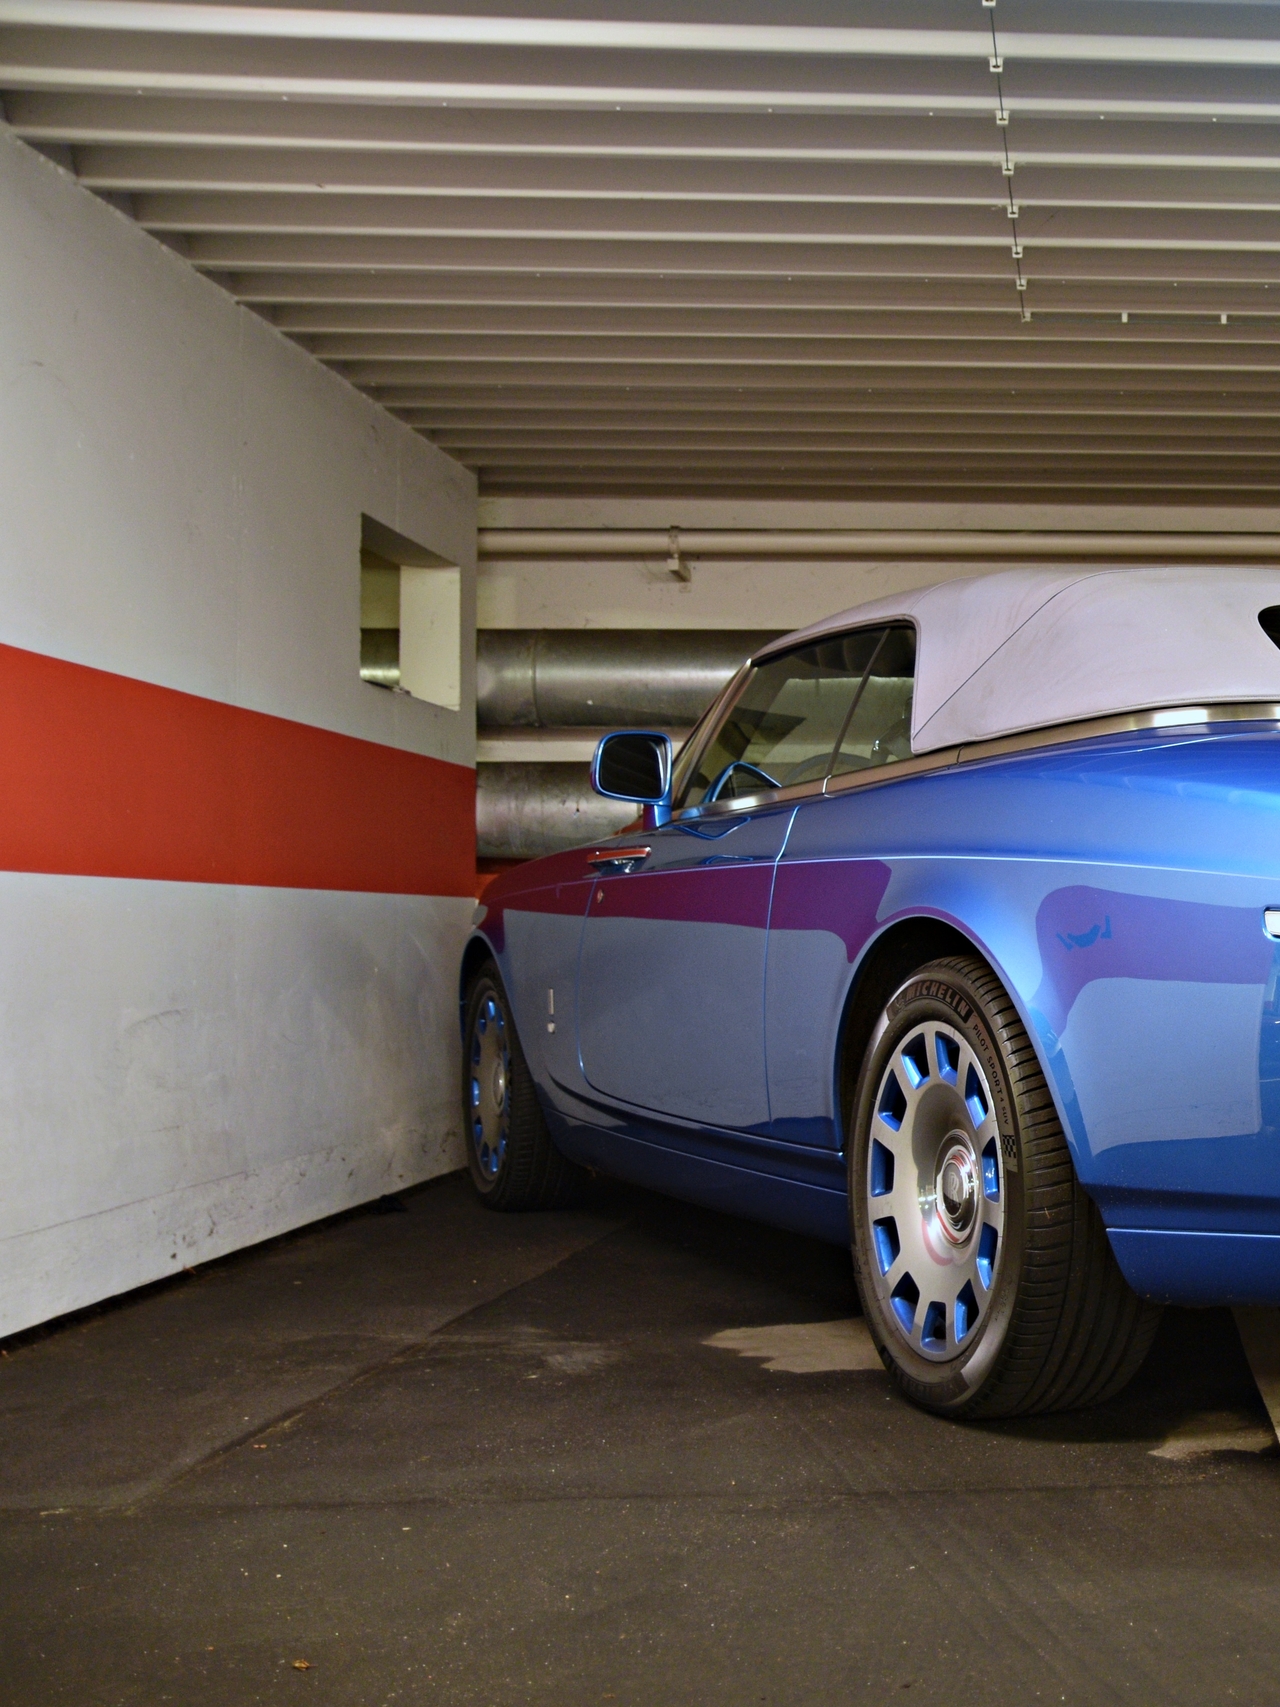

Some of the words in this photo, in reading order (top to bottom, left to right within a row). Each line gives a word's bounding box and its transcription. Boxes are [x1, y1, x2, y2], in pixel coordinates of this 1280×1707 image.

[906, 980, 970, 1017] MICHELIN
[972, 1024, 989, 1052] PILOT
[986, 1056, 1003, 1095] SPORT
